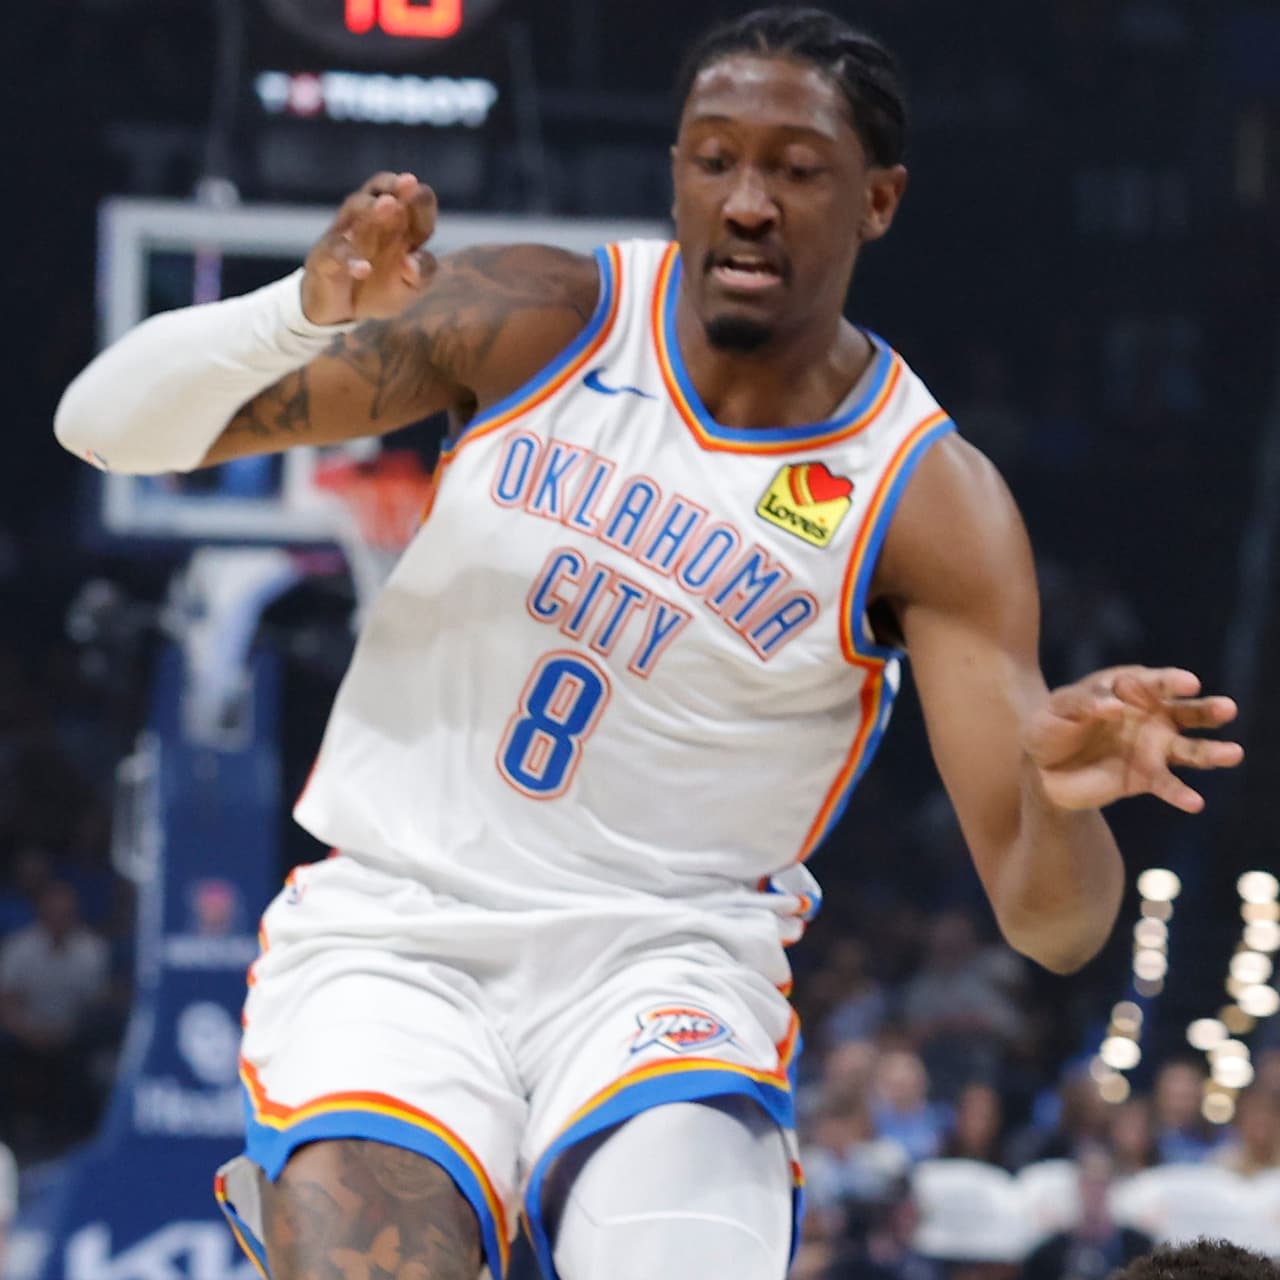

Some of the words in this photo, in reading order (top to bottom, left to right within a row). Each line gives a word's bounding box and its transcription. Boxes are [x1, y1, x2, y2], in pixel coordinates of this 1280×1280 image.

[490, 430, 820, 662] OKLAHOMA
[526, 547, 693, 680] CITY
[495, 649, 613, 801] 8
